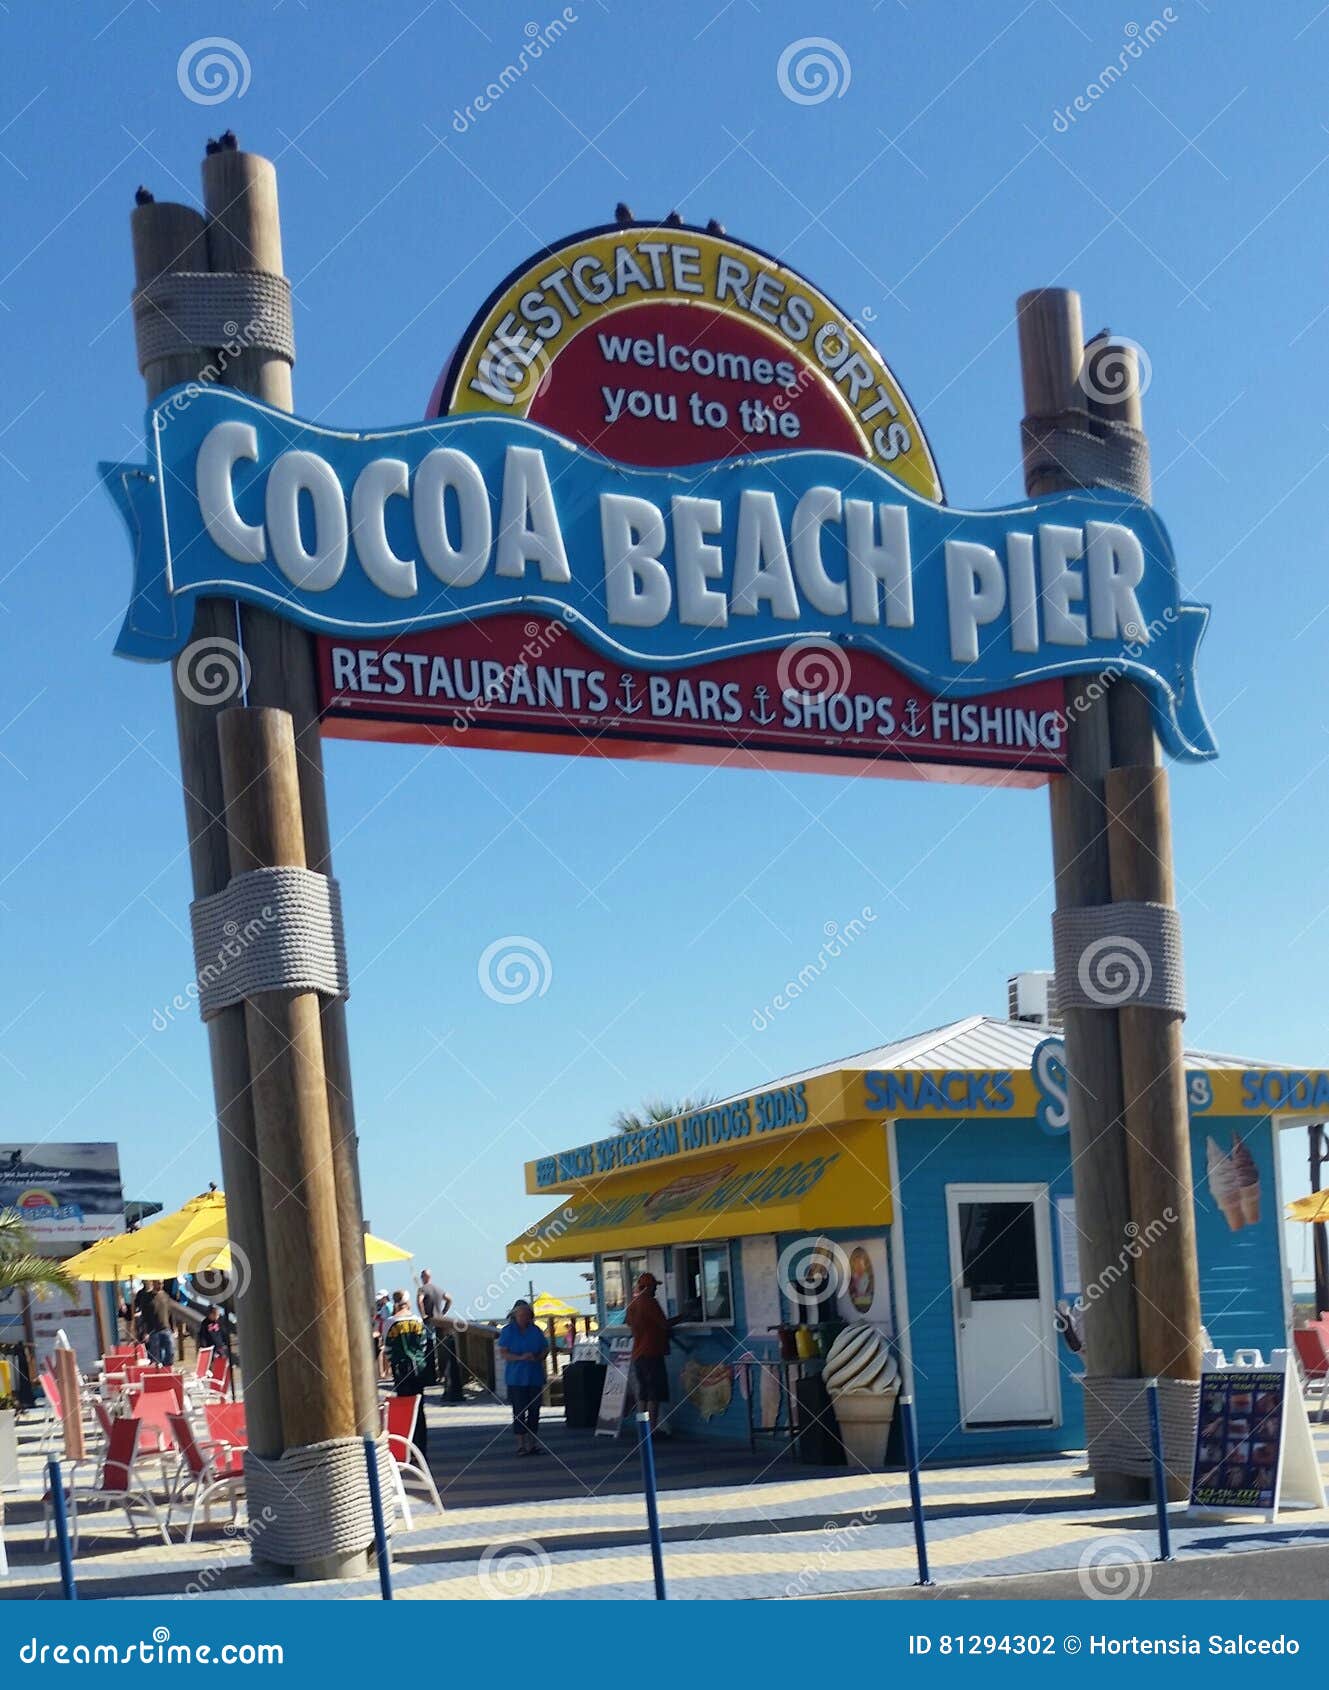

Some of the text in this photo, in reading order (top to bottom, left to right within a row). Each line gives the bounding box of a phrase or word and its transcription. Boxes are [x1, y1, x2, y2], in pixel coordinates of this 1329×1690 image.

[468, 243, 912, 462] WESTGATE RESORTS
[597, 333, 798, 386] welcomes
[600, 386, 801, 439] you to the
[196, 420, 1149, 663] COCOA BEACH PIER
[331, 647, 1062, 750] RESTAURANTS BARS SHOPS FISHING
[754, 1082, 808, 1132] SODAS
[864, 1069, 1015, 1112] SNACKS
